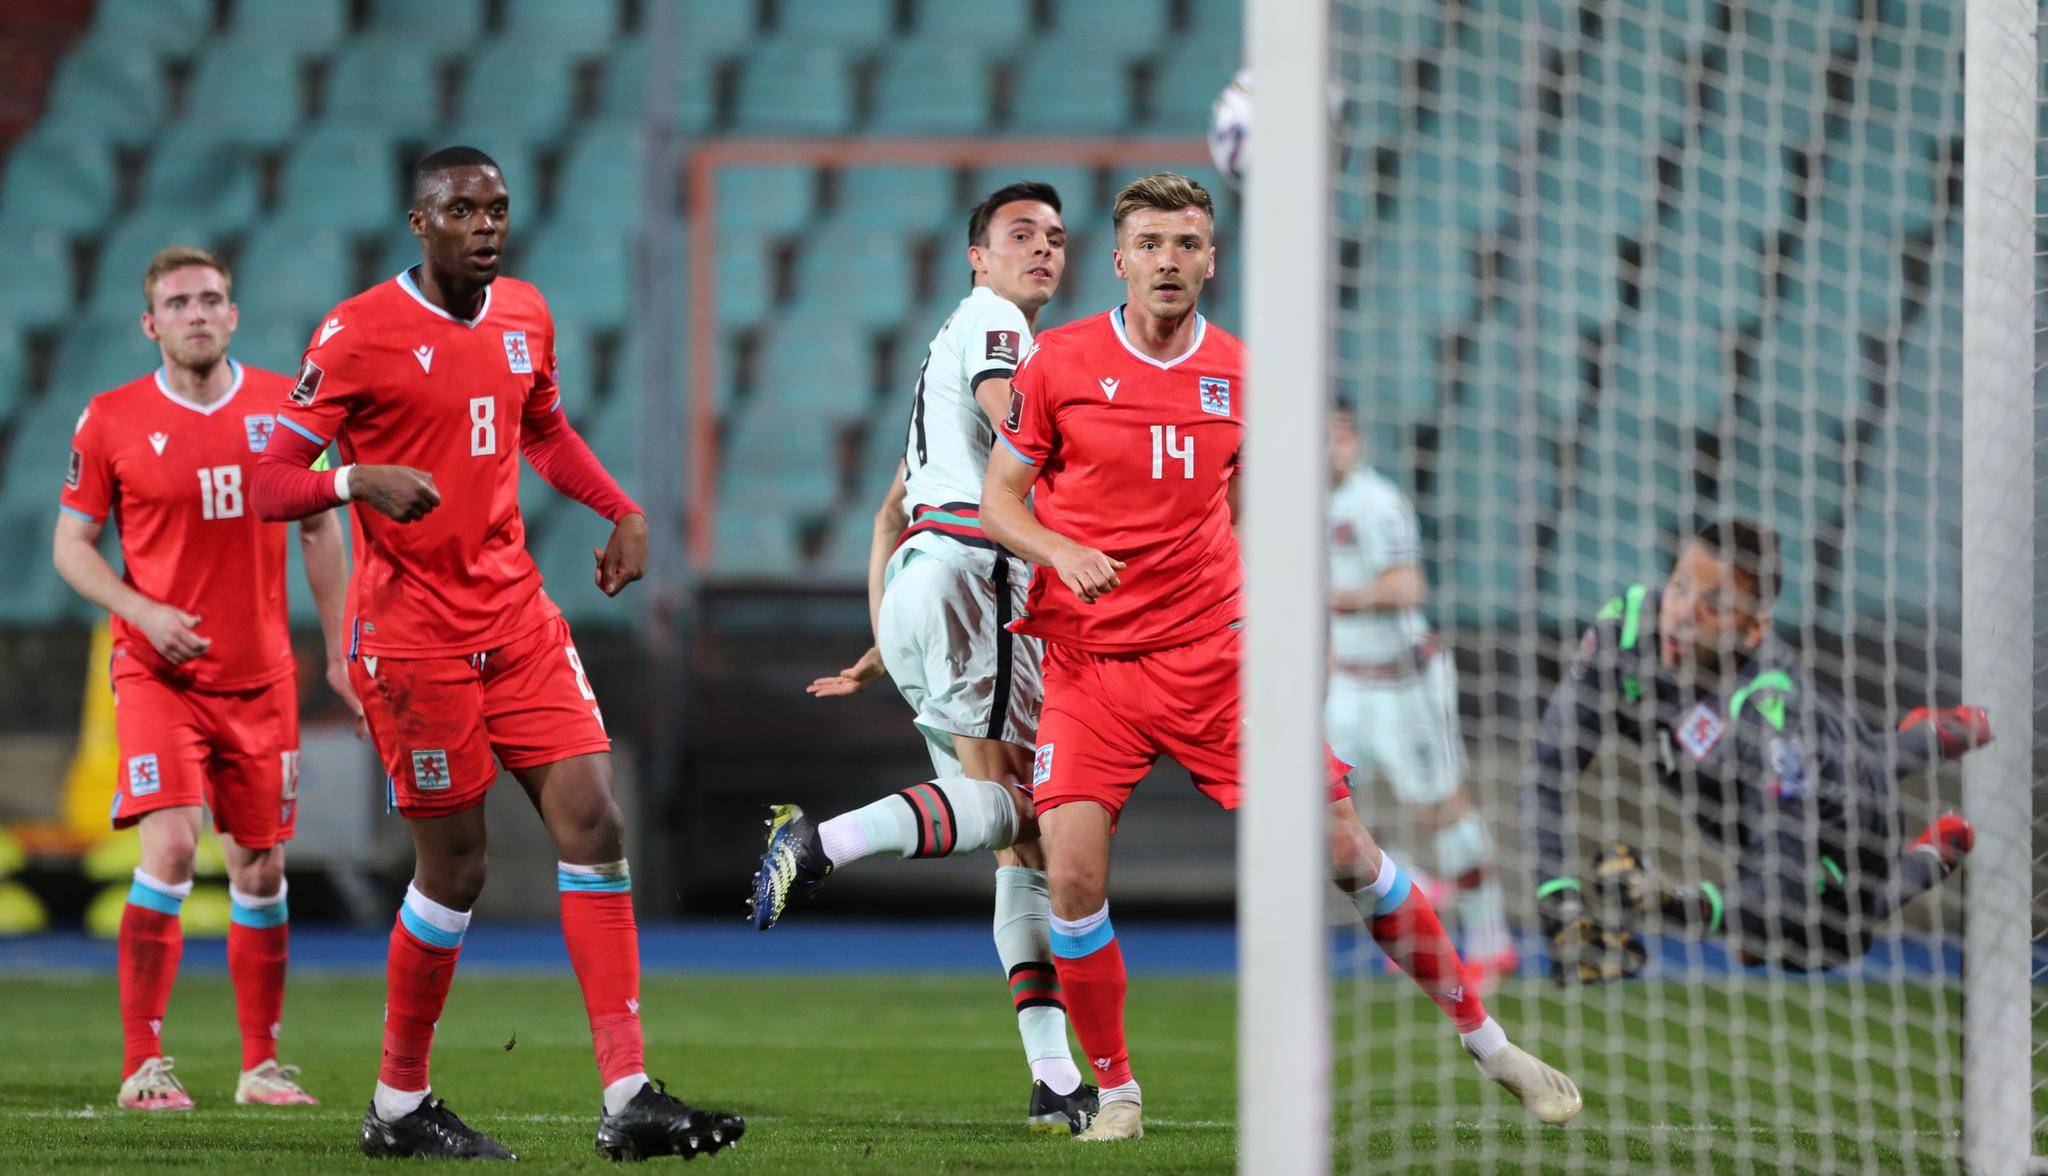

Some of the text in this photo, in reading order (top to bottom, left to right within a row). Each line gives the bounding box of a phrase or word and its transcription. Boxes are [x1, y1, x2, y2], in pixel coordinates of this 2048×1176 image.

[469, 396, 496, 457] 8
[1150, 425, 1195, 479] 14
[196, 464, 245, 520] 18
[565, 646, 596, 701] 8
